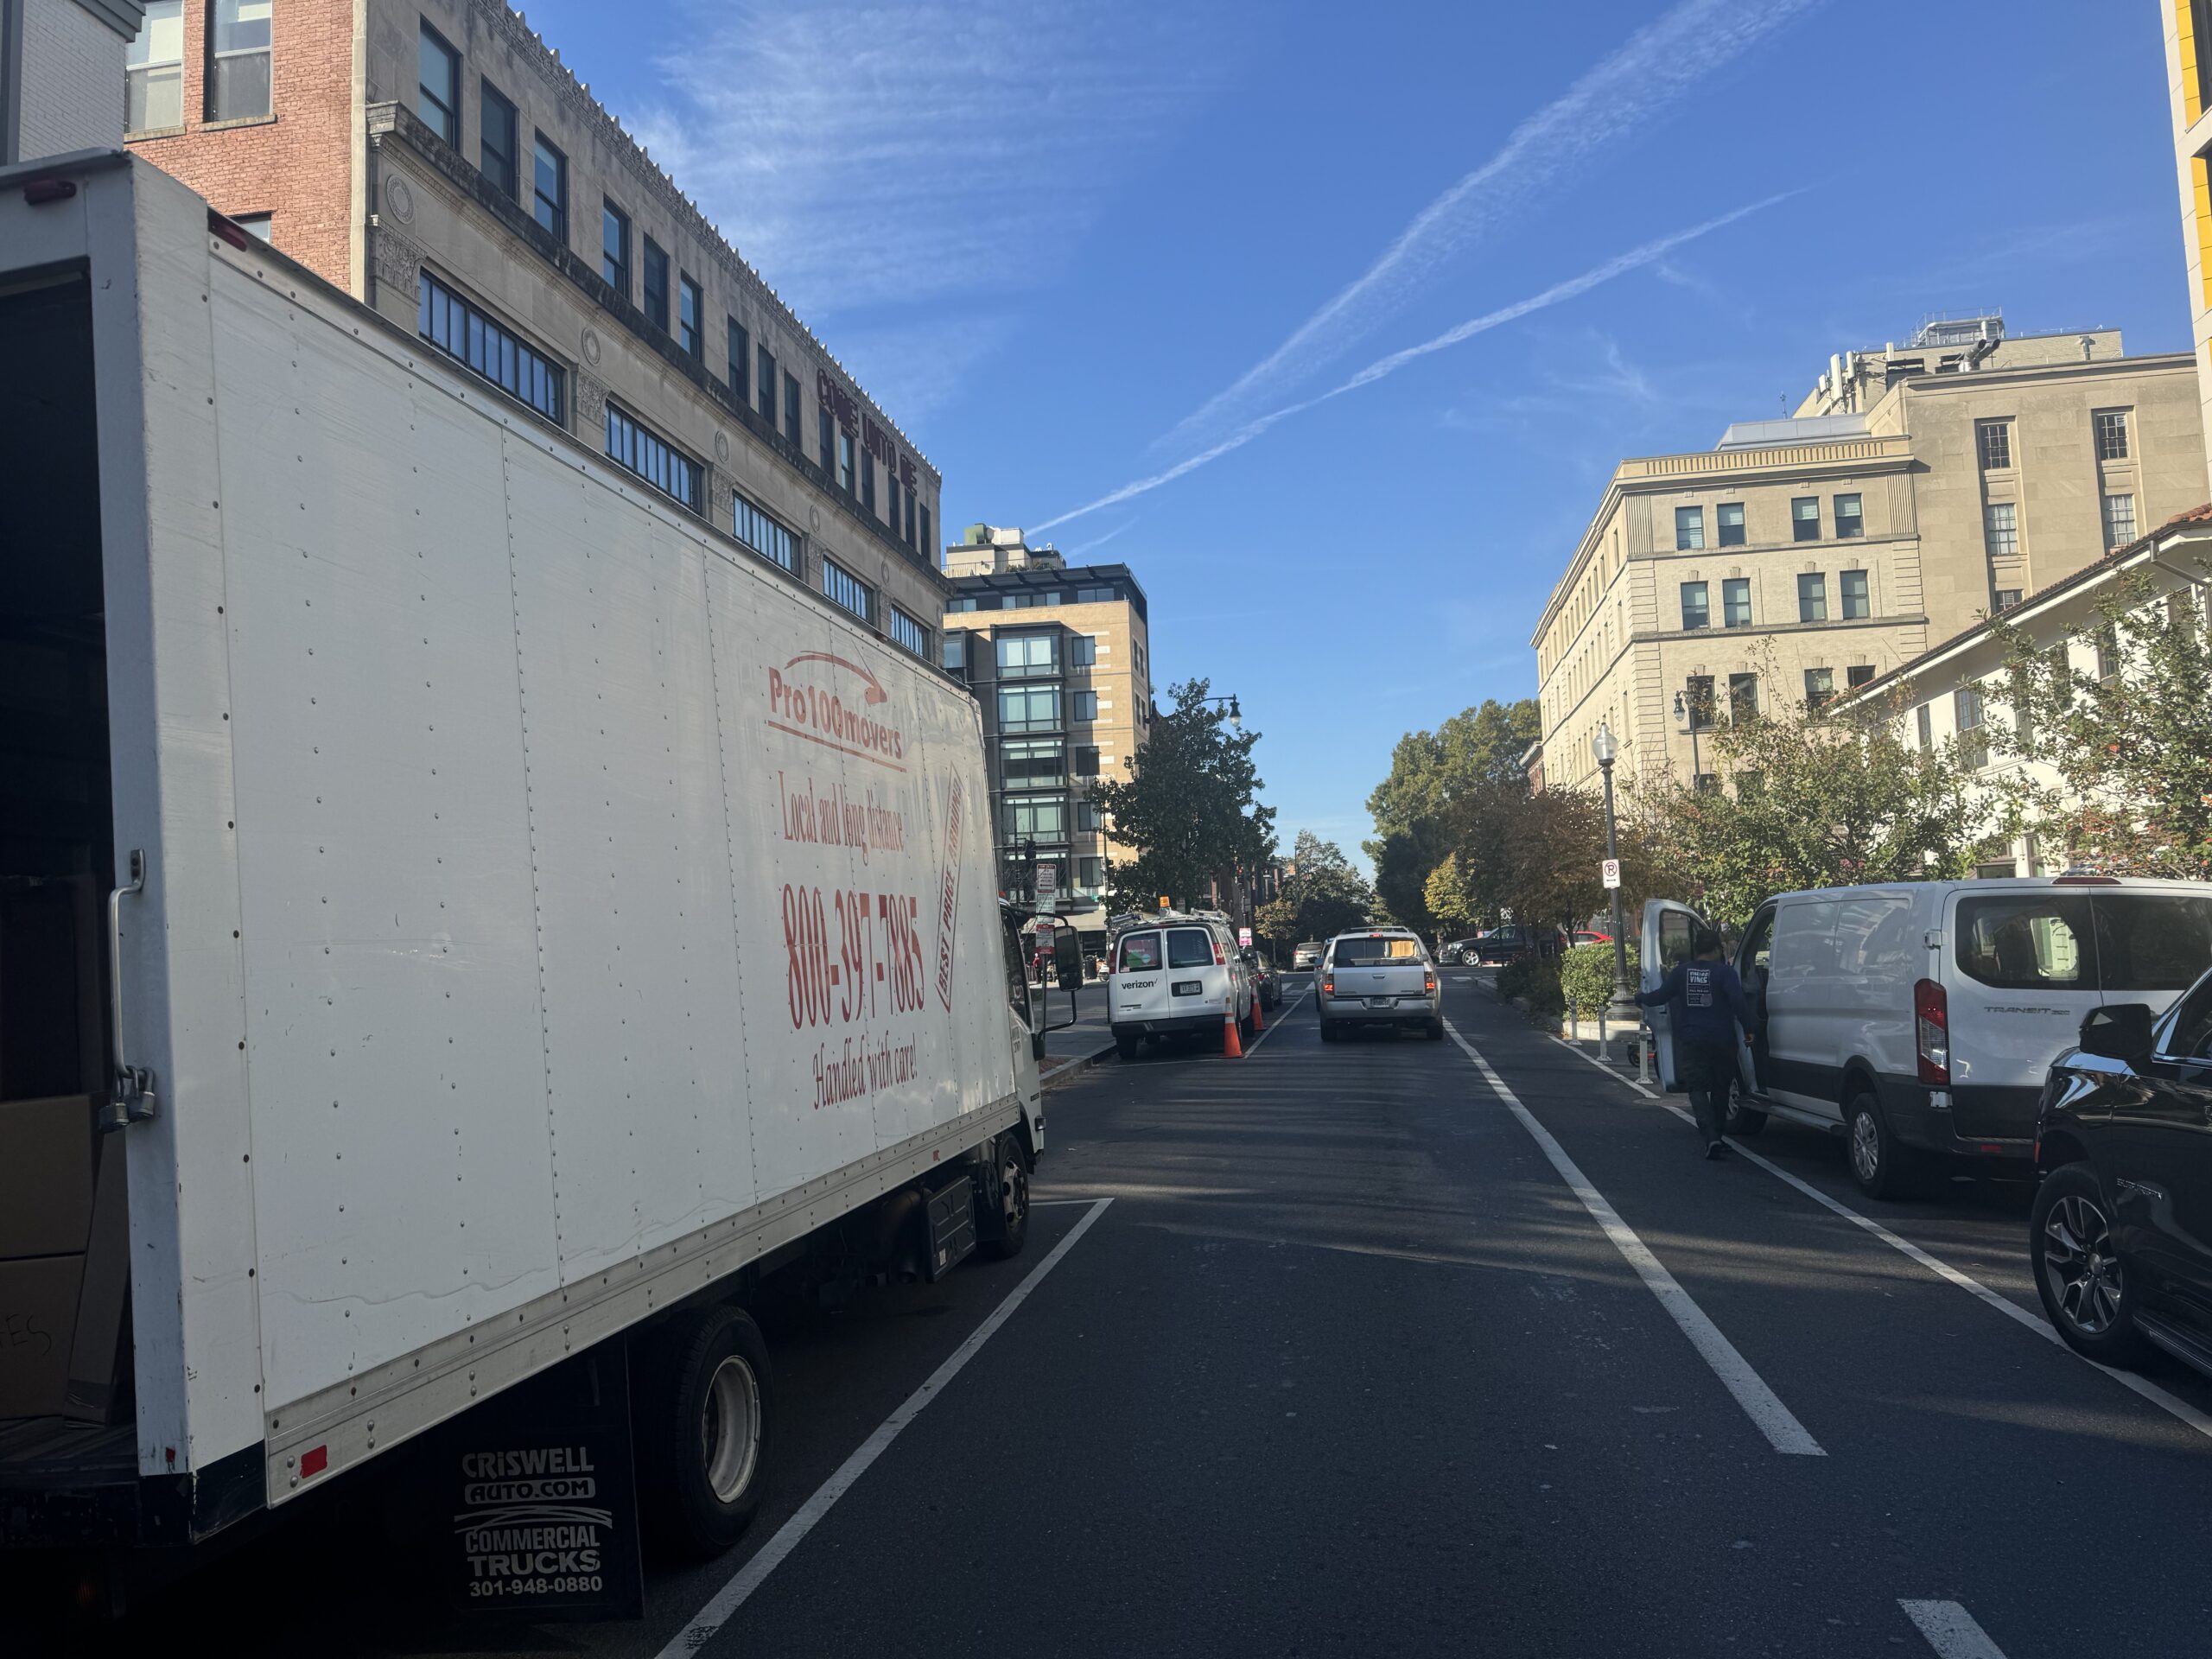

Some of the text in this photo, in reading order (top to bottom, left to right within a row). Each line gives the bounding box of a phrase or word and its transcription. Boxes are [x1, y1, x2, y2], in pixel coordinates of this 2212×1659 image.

[769, 667, 902, 760] Pro100movers
[779, 771, 905, 867] Local and long distance
[943, 864, 955, 933] PRICE
[783, 883, 925, 1030] 800-397-7885
[939, 931, 950, 995] BEST
[1122, 980, 1154, 989] verizon
[813, 1030, 918, 1109] Handled with care!
[469, 1479, 590, 1502] AUTO.COM
[465, 1525, 601, 1553] COMMERCIAL
[467, 1549, 601, 1576] TRUCKS
[469, 1575, 602, 1597] 301-948-0880
